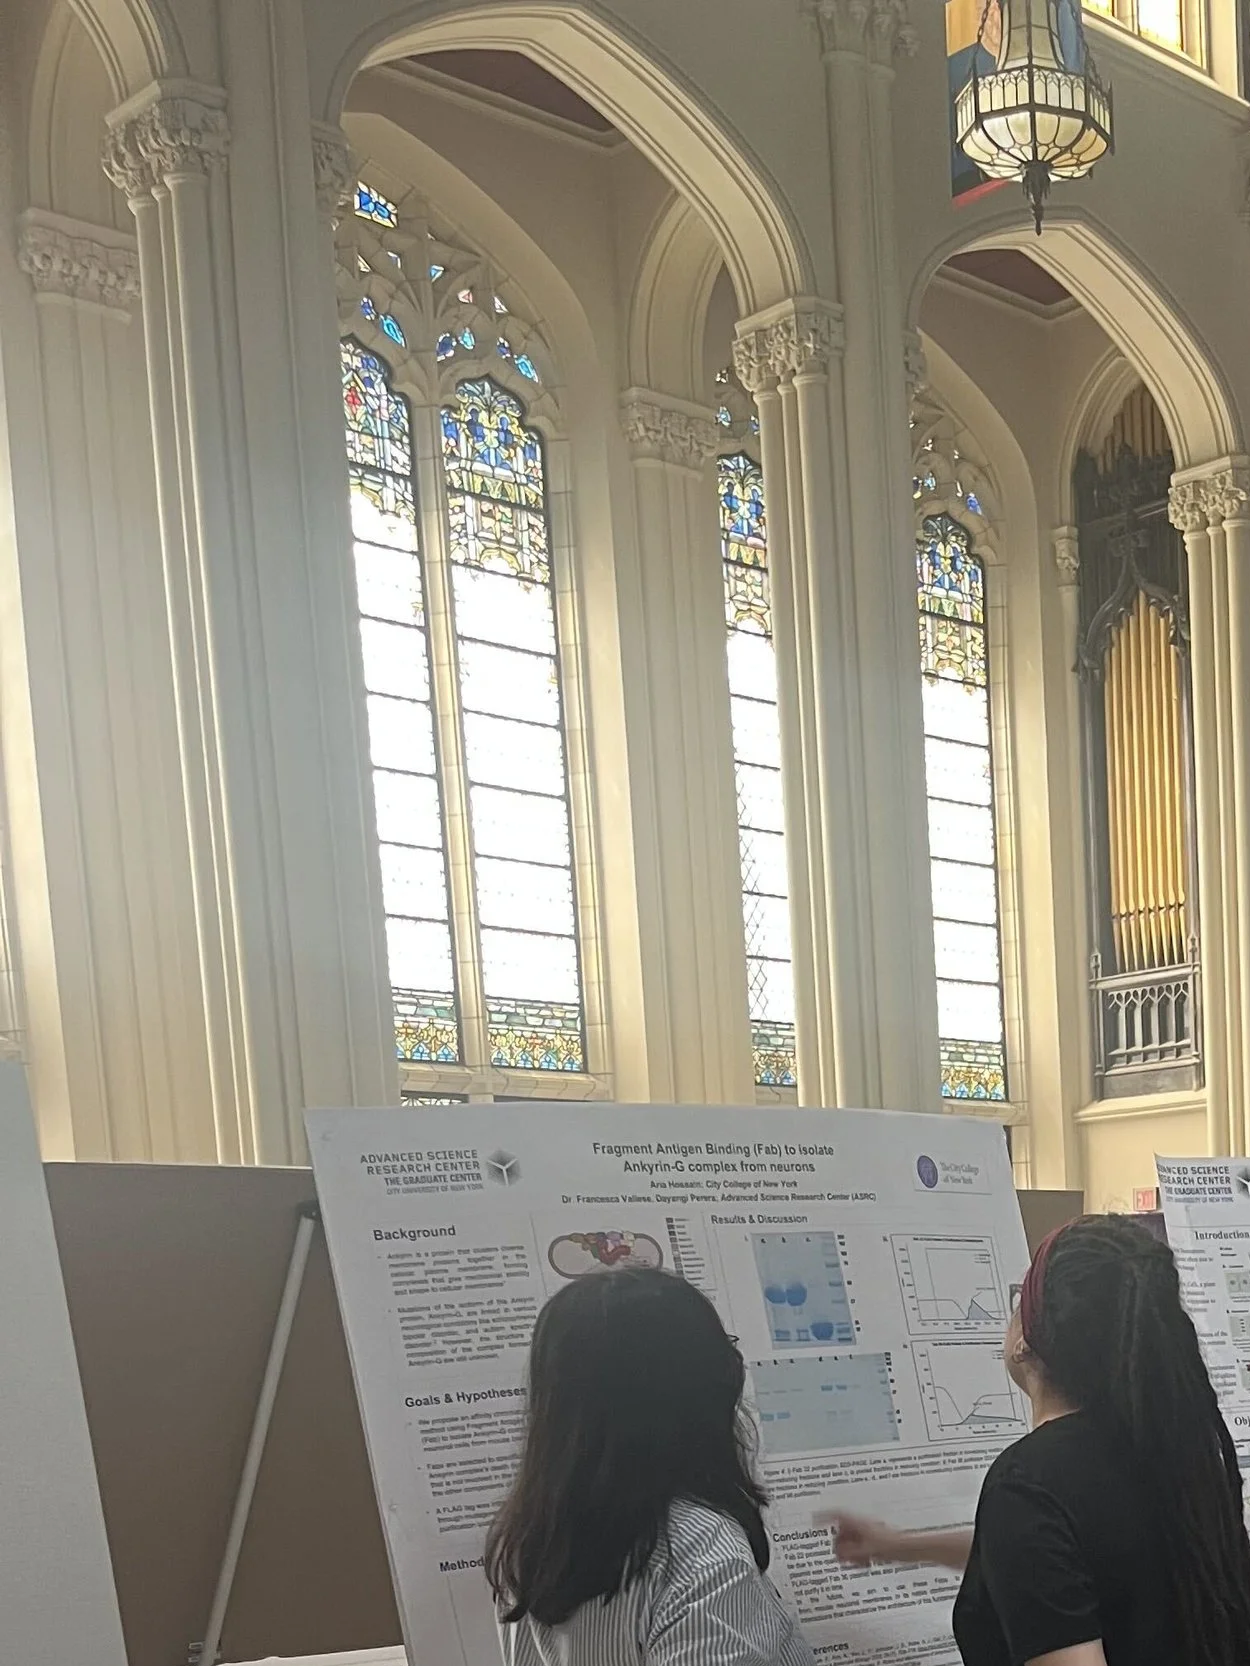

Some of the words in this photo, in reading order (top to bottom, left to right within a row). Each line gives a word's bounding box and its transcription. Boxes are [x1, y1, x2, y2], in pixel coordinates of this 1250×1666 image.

[360, 1152, 423, 1164] ADVANCED
[427, 1149, 478, 1160] SCIENCE
[593, 1143, 652, 1157] Fragment
[656, 1143, 702, 1157] Antigen
[706, 1143, 750, 1157] Binding
[753, 1143, 782, 1157] (Fab)
[785, 1144, 796, 1155] to
[367, 1162, 431, 1175] RESEARCH
[435, 1161, 480, 1172] CENTER
[624, 1161, 684, 1175] Ankyrin-G
[688, 1161, 738, 1174] complex
[741, 1160, 767, 1172] from
[770, 1163, 815, 1173] neurons
[1191, 1166, 1230, 1175] SCIENCE
[384, 1176, 401, 1186] THE
[403, 1174, 448, 1185] GRADUATE
[450, 1172, 482, 1182] CENTER
[706, 1181, 721, 1190] City
[722, 1181, 751, 1189] College
[753, 1180, 761, 1188] of
[1197, 1176, 1231, 1185] CENTER
[1208, 1186, 1232, 1194] CENTER
[721, 1193, 758, 1201] Advanced
[760, 1193, 790, 1201] Science
[791, 1193, 826, 1201] Research
[711, 1215, 746, 1224] Results
[749, 1215, 755, 1224] &
[757, 1214, 808, 1224] Discussion
[373, 1225, 456, 1241] Background
[1194, 1230, 1250, 1240] Introduction
[405, 1395, 440, 1408] Goals
[445, 1393, 453, 1404] &
[456, 1387, 527, 1404] Hypotheses
[773, 1529, 828, 1542] Conclusions
[439, 1557, 485, 1572] Method
[813, 1643, 849, 1655] erences
